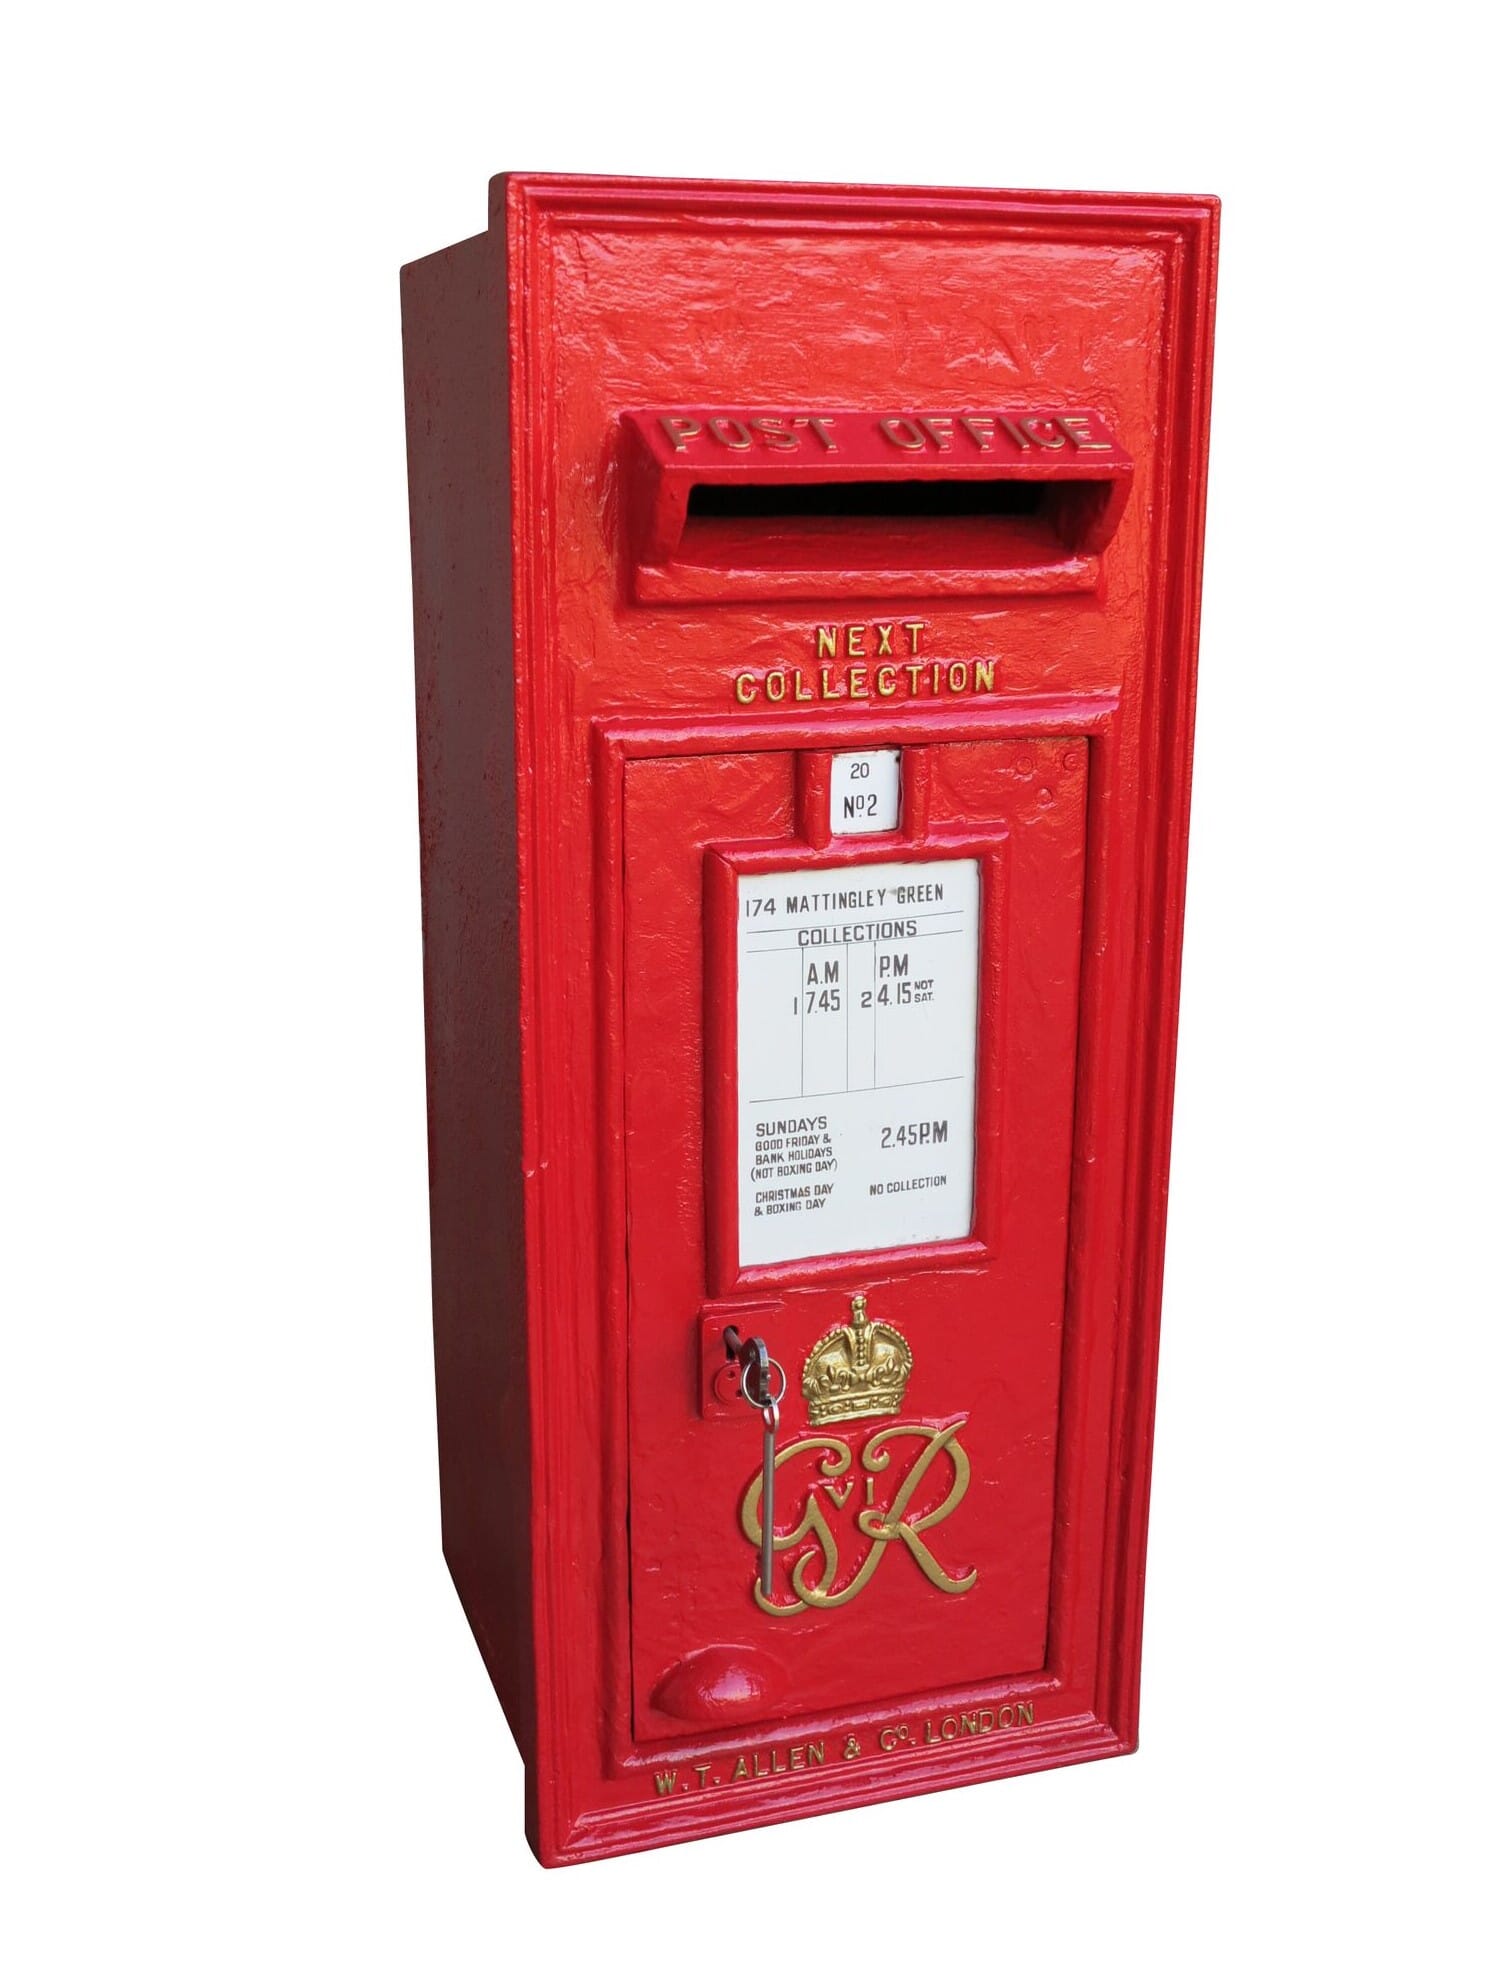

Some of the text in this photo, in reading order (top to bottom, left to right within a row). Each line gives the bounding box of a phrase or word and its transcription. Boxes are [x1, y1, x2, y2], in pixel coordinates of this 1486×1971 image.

[657, 415, 1113, 452] POST OFFICE
[816, 622, 929, 658] NEXT
[735, 660, 996, 704] COLLECTION
[849, 762, 870, 779] 20
[746, 883, 944, 918] 174 MATTINGLEY GREEN
[797, 919, 918, 947] COLLECTIONS
[861, 981, 912, 1009] 2 4.15
[914, 979, 935, 991] NOT
[805, 989, 841, 1015] 7.45
[755, 1115, 828, 1138] SUNDAYS
[755, 1133, 832, 1152] GOOD FRIDAY &
[755, 1146, 833, 1166] BANK HOLIDAYS
[750, 1158, 838, 1183] (NOT BOXING DAY)
[755, 1183, 835, 1204] CHRISTMAS DAY
[869, 1175, 947, 1196] NO COLLECTION
[754, 1198, 826, 1217] & BOXING DAY
[731, 1741, 826, 1783] ALLEN
[842, 1733, 862, 1762] &
[923, 1702, 1035, 1745] LONDON
